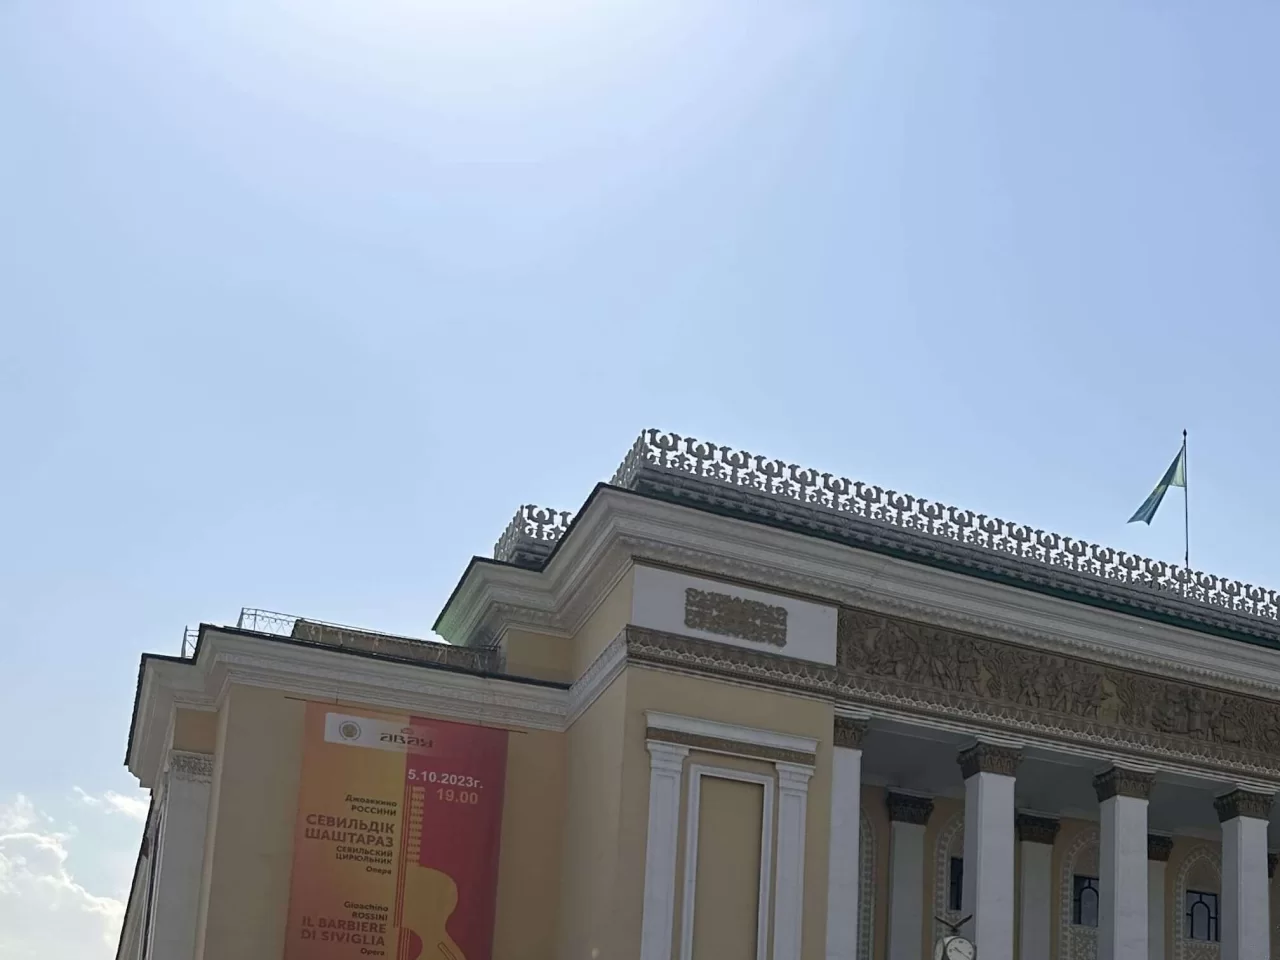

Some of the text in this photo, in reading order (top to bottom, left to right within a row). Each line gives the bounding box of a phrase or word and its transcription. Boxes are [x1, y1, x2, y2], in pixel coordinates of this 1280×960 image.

[407, 769, 483, 789] 5.10.2023г.
[437, 787, 479, 804] 19.00
[351, 804, 397, 816] РОССИНИ
[306, 813, 395, 834] СЕВИЛЬДІК
[305, 827, 394, 848] ШАШТАРАЗ
[336, 845, 393, 857] СЕВИЛЬСКИЙ
[336, 853, 392, 865] ЦИРЮЛЬНИК
[366, 865, 392, 875] Опера
[344, 901, 389, 912] Gioachino
[352, 911, 388, 921] ROSSINI
[302, 915, 387, 934] IL BARBIERE
[301, 929, 385, 946] DI SIVIGLIA
[360, 947, 385, 956] Opera
